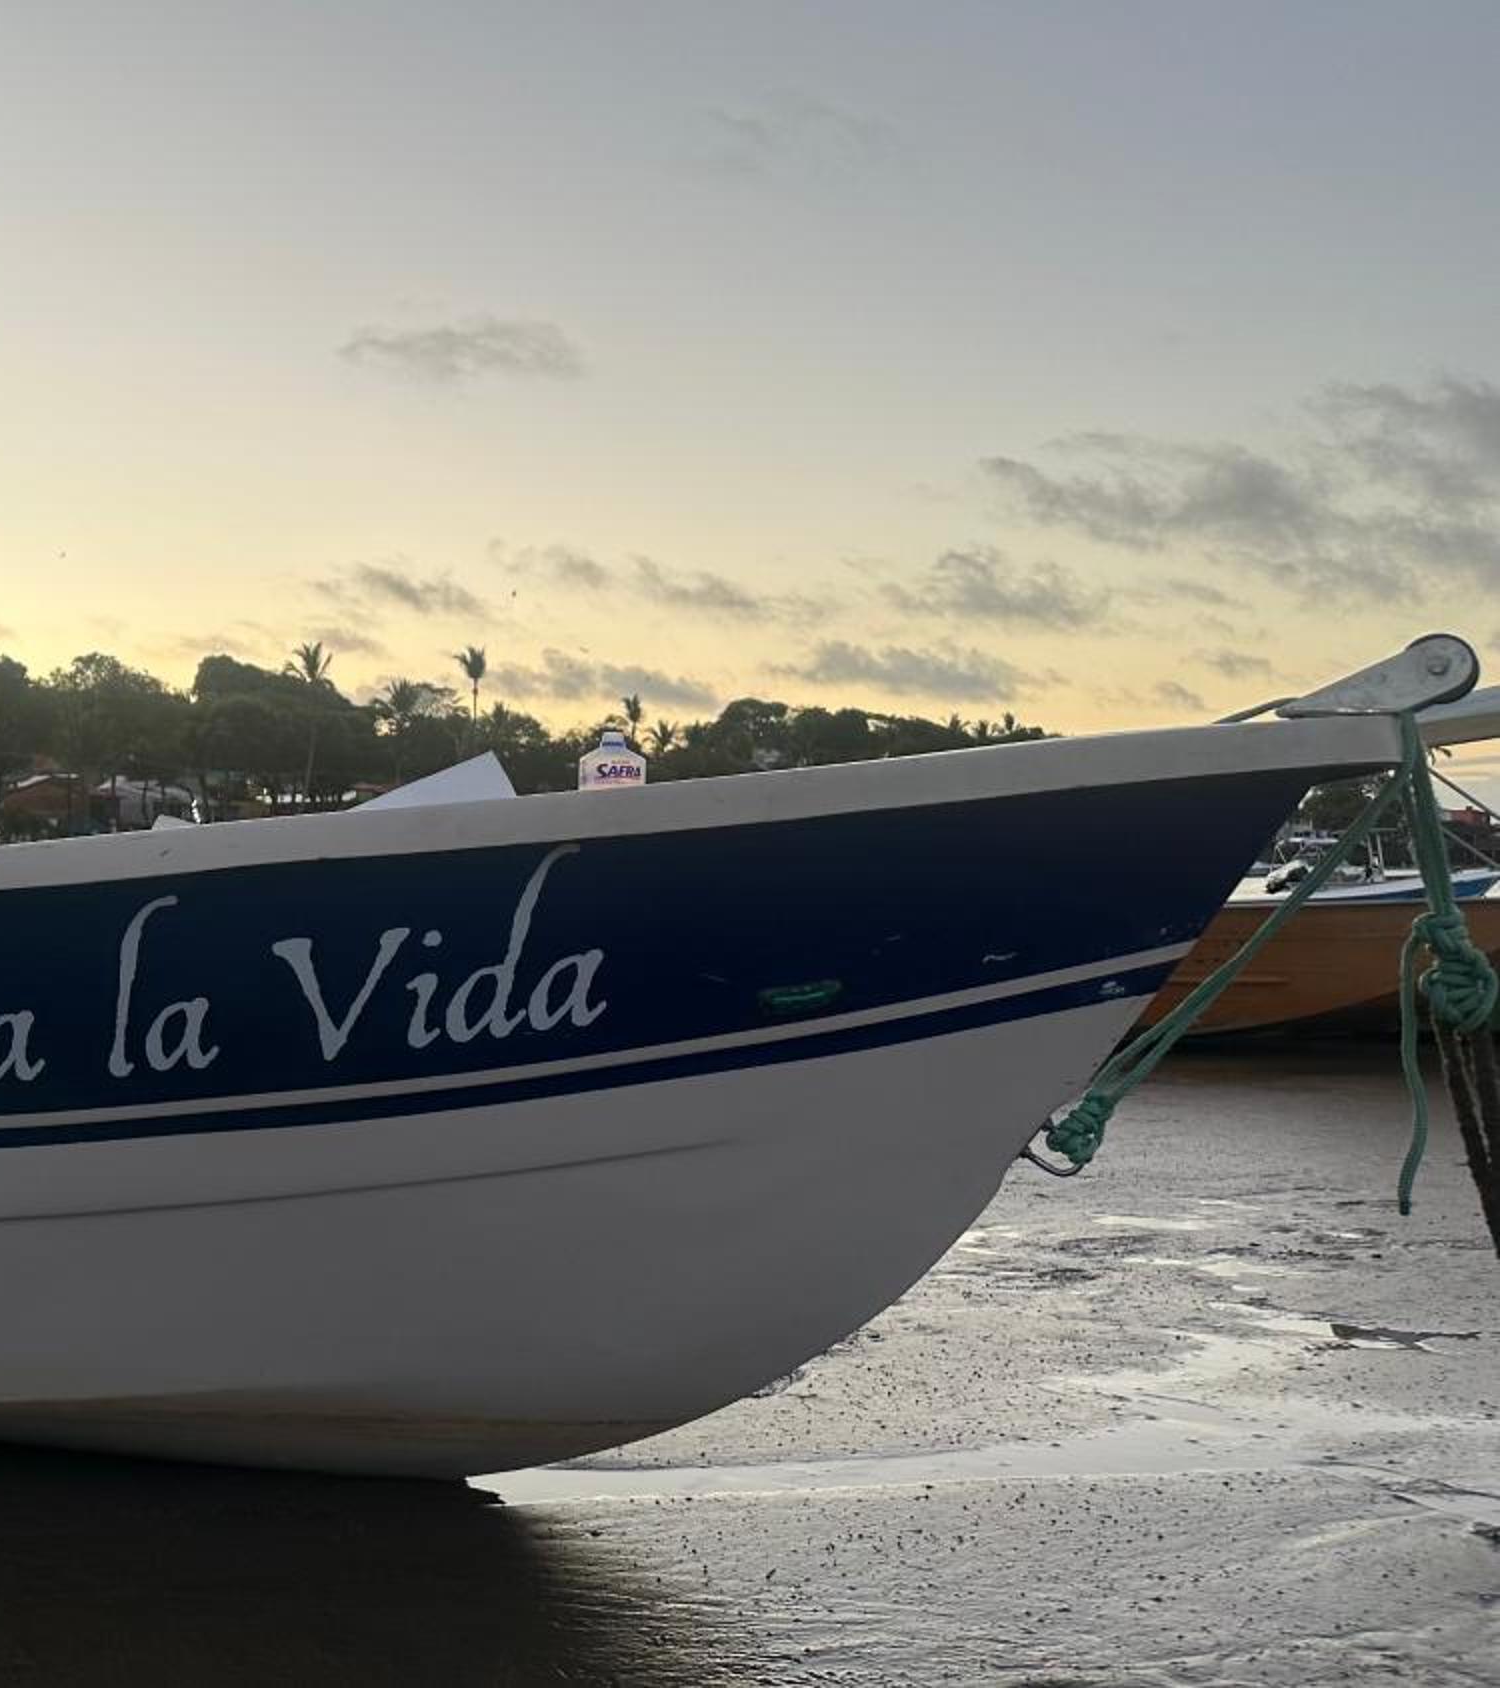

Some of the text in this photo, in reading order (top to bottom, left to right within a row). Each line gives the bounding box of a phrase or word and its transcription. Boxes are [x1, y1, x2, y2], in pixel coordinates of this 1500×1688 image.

[596, 763, 642, 779] SAFRA
[108, 895, 219, 1077] la
[272, 843, 607, 1061] Vida
